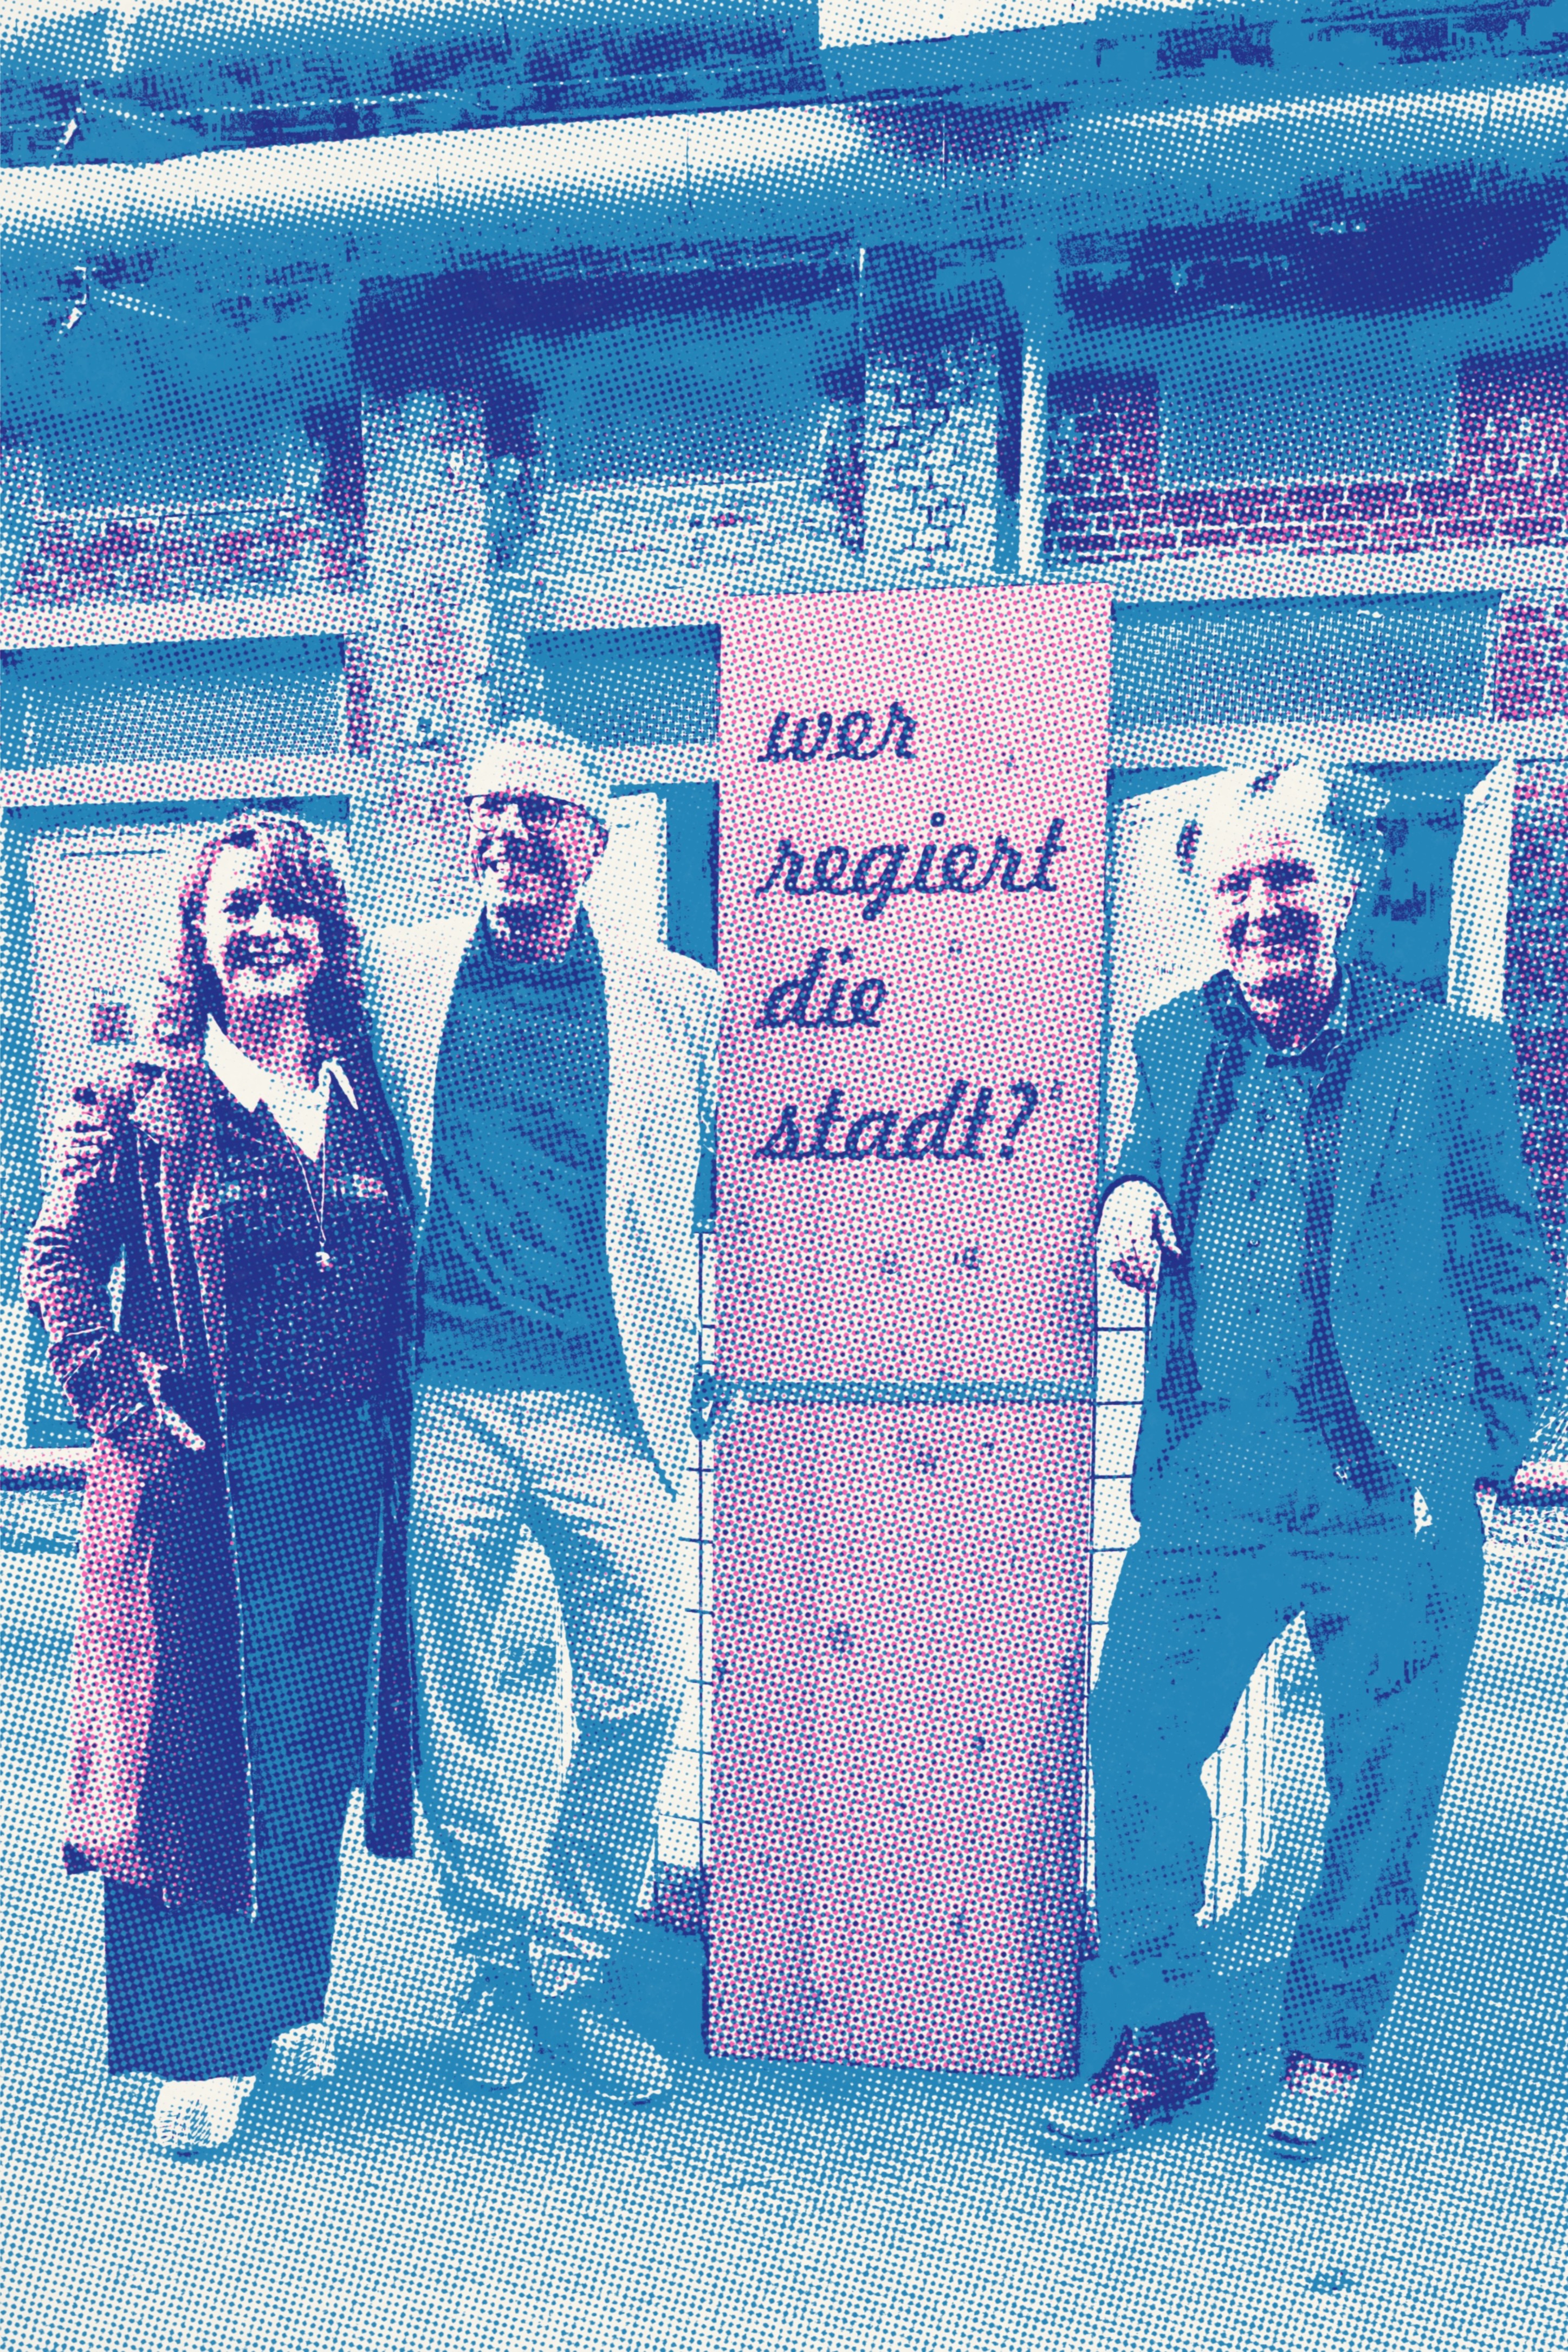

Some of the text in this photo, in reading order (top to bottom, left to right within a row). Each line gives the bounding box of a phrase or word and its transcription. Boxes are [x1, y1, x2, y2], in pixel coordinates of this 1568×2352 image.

[757, 701, 917, 762] wer
[755, 812, 1067, 921] regiert
[754, 947, 887, 1028] die
[753, 1079, 1039, 1161] stadt?
